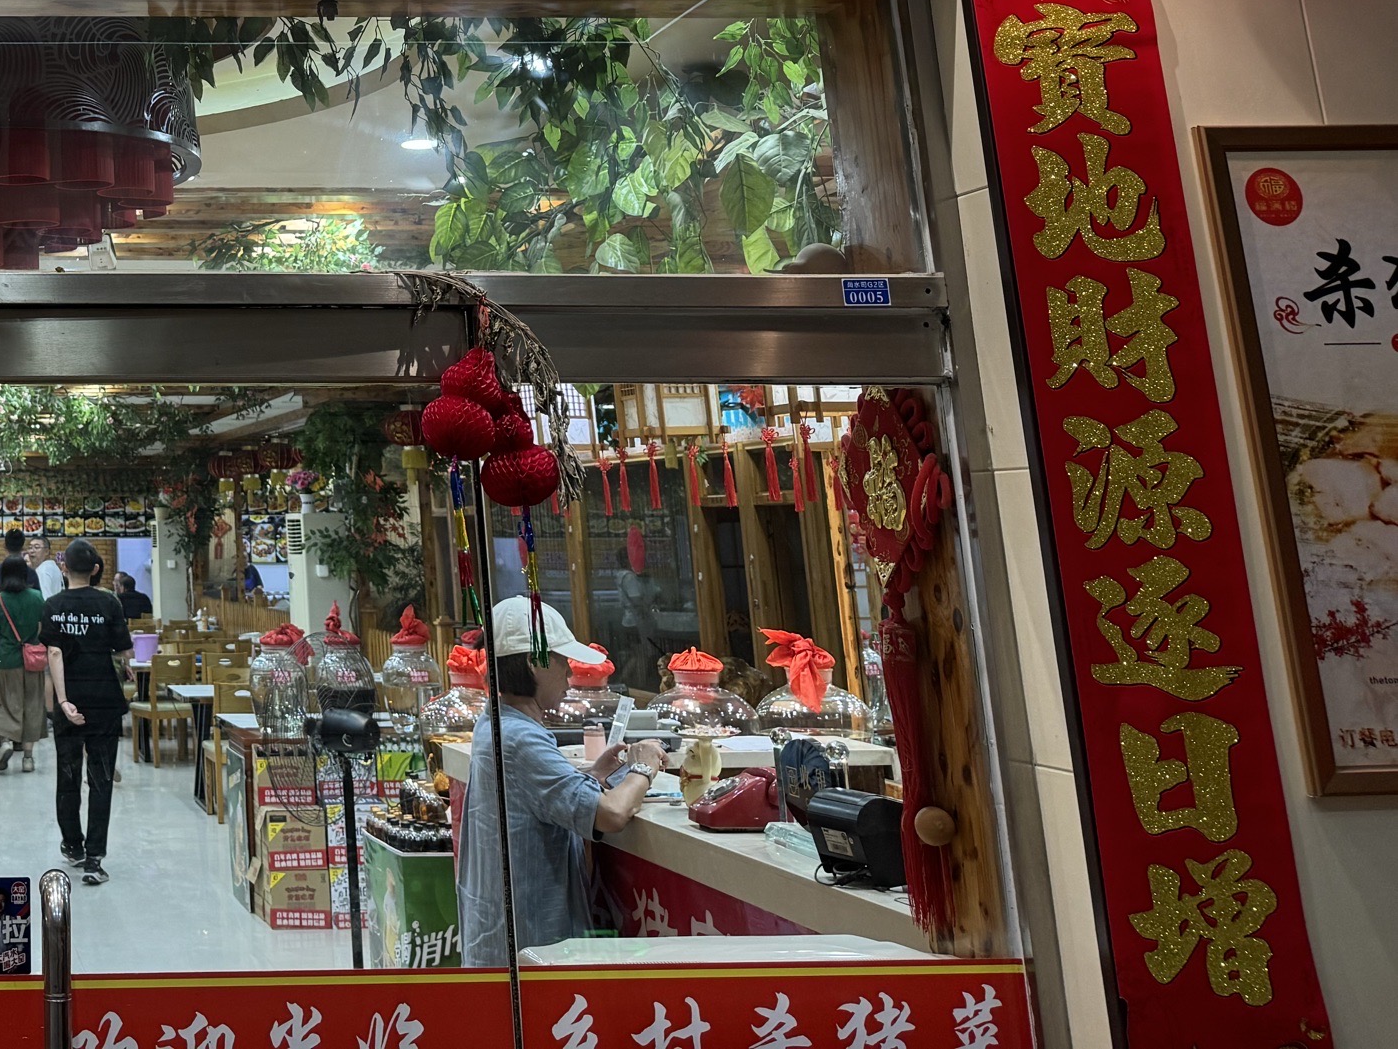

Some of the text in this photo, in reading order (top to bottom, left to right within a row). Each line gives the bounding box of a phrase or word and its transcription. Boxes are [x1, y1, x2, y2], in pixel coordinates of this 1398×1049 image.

[1303, 237, 1398, 329] 杀
[849, 291, 884, 303] 0005
[67, 612, 78, 623] de
[80, 613, 89, 624] la
[91, 614, 105, 624] vie
[60, 623, 89, 635] ADLV
[2, 915, 29, 944] 拉
